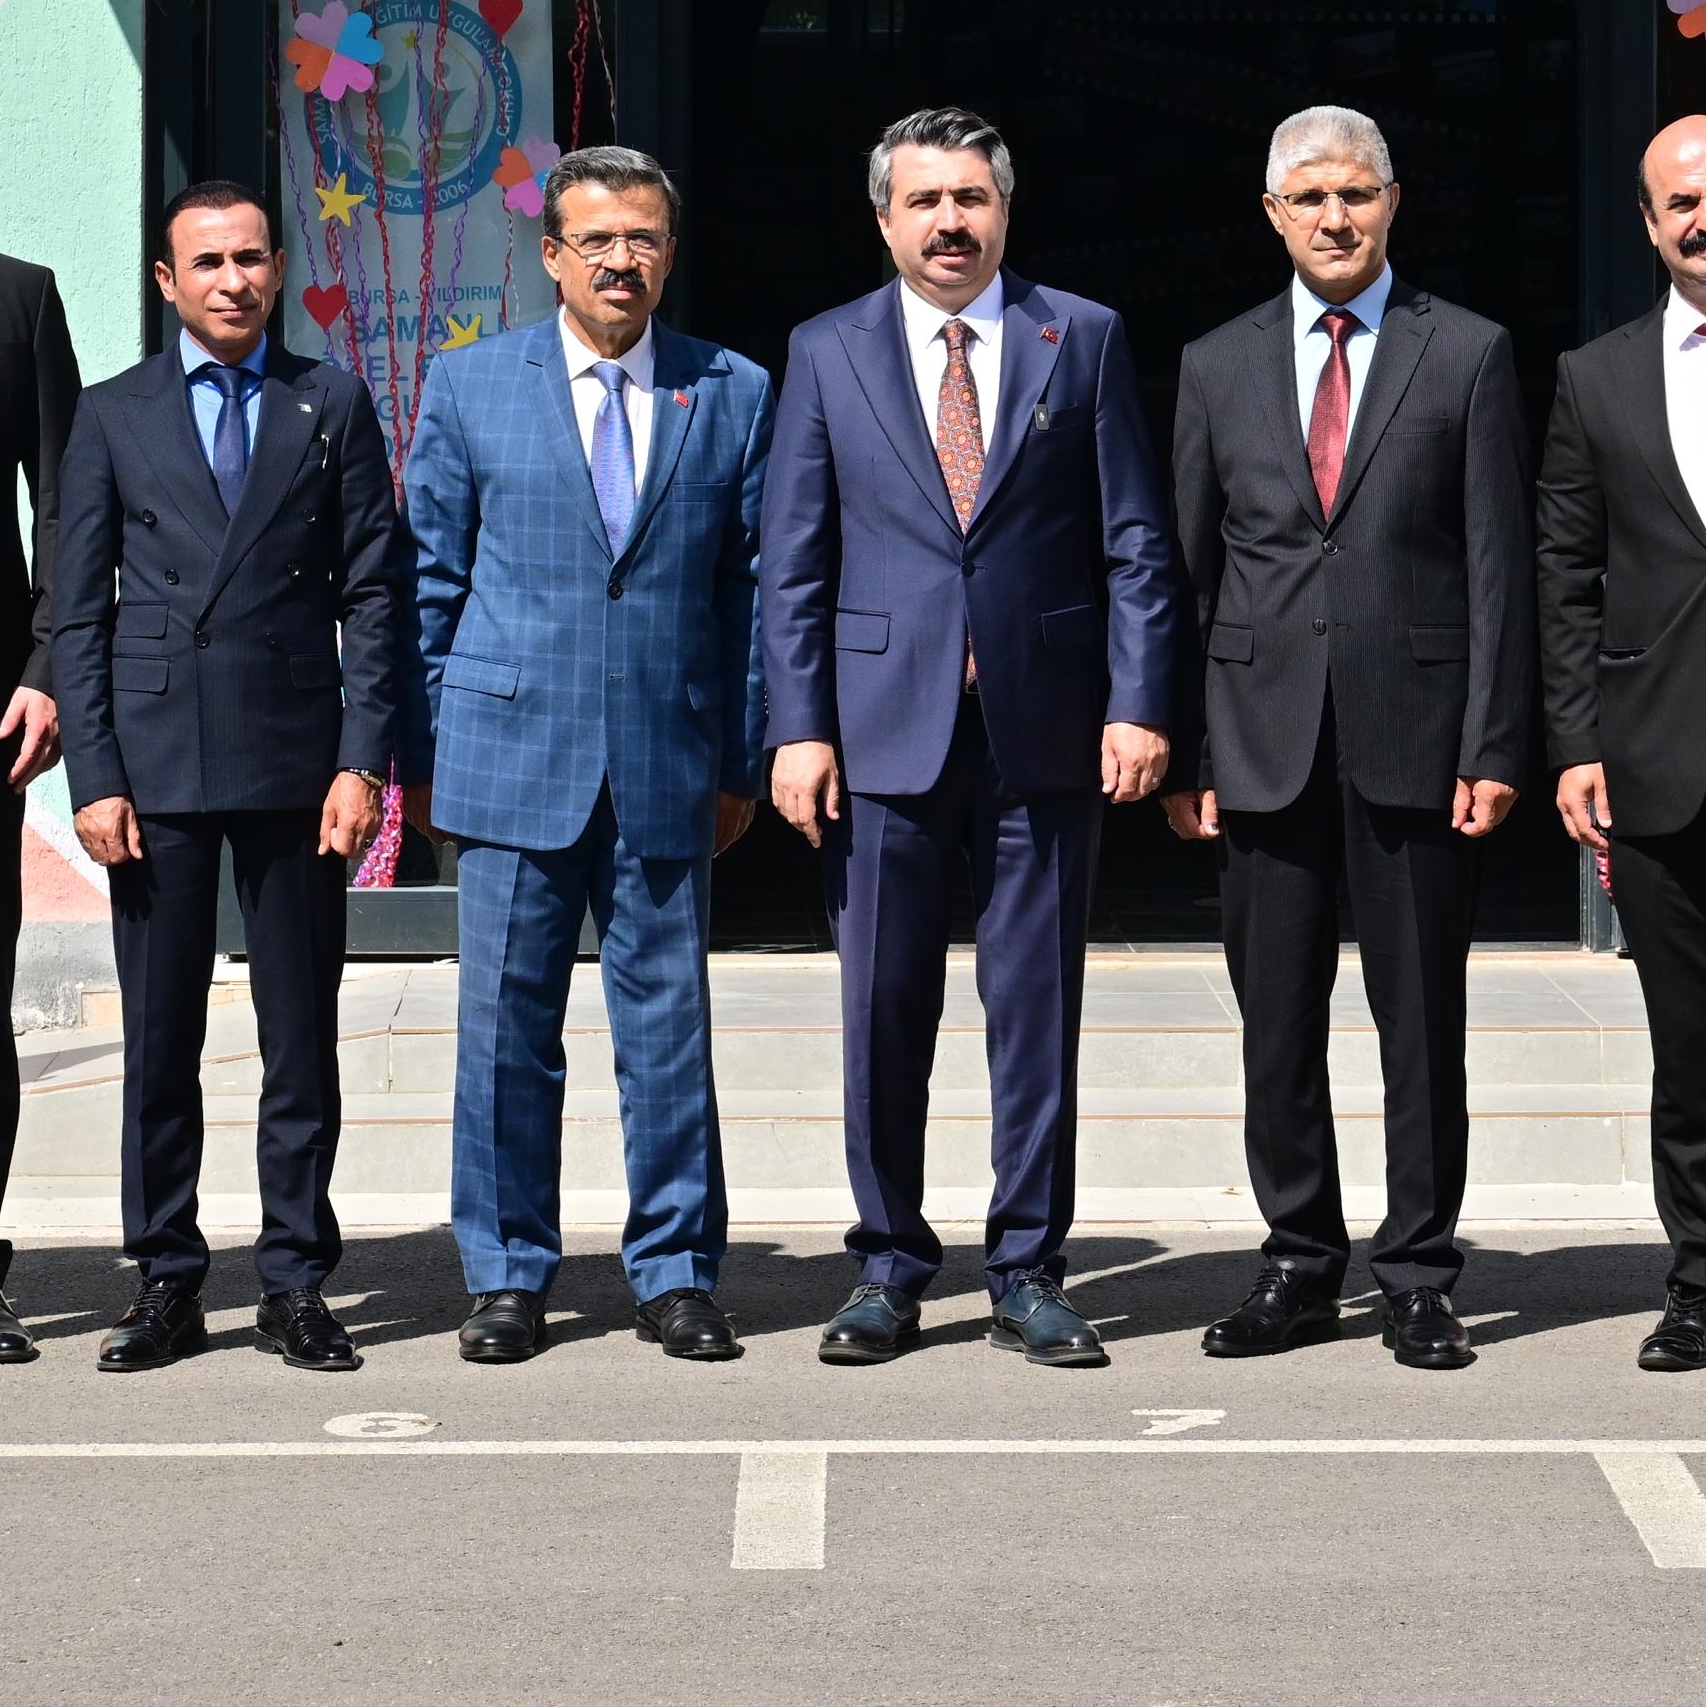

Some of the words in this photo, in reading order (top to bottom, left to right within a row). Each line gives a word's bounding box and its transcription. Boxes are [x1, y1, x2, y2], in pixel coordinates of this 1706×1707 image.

[432, 180, 468, 206] 006
[430, 285, 502, 302] ILDIRIM
[322, 1411, 436, 1438] 6
